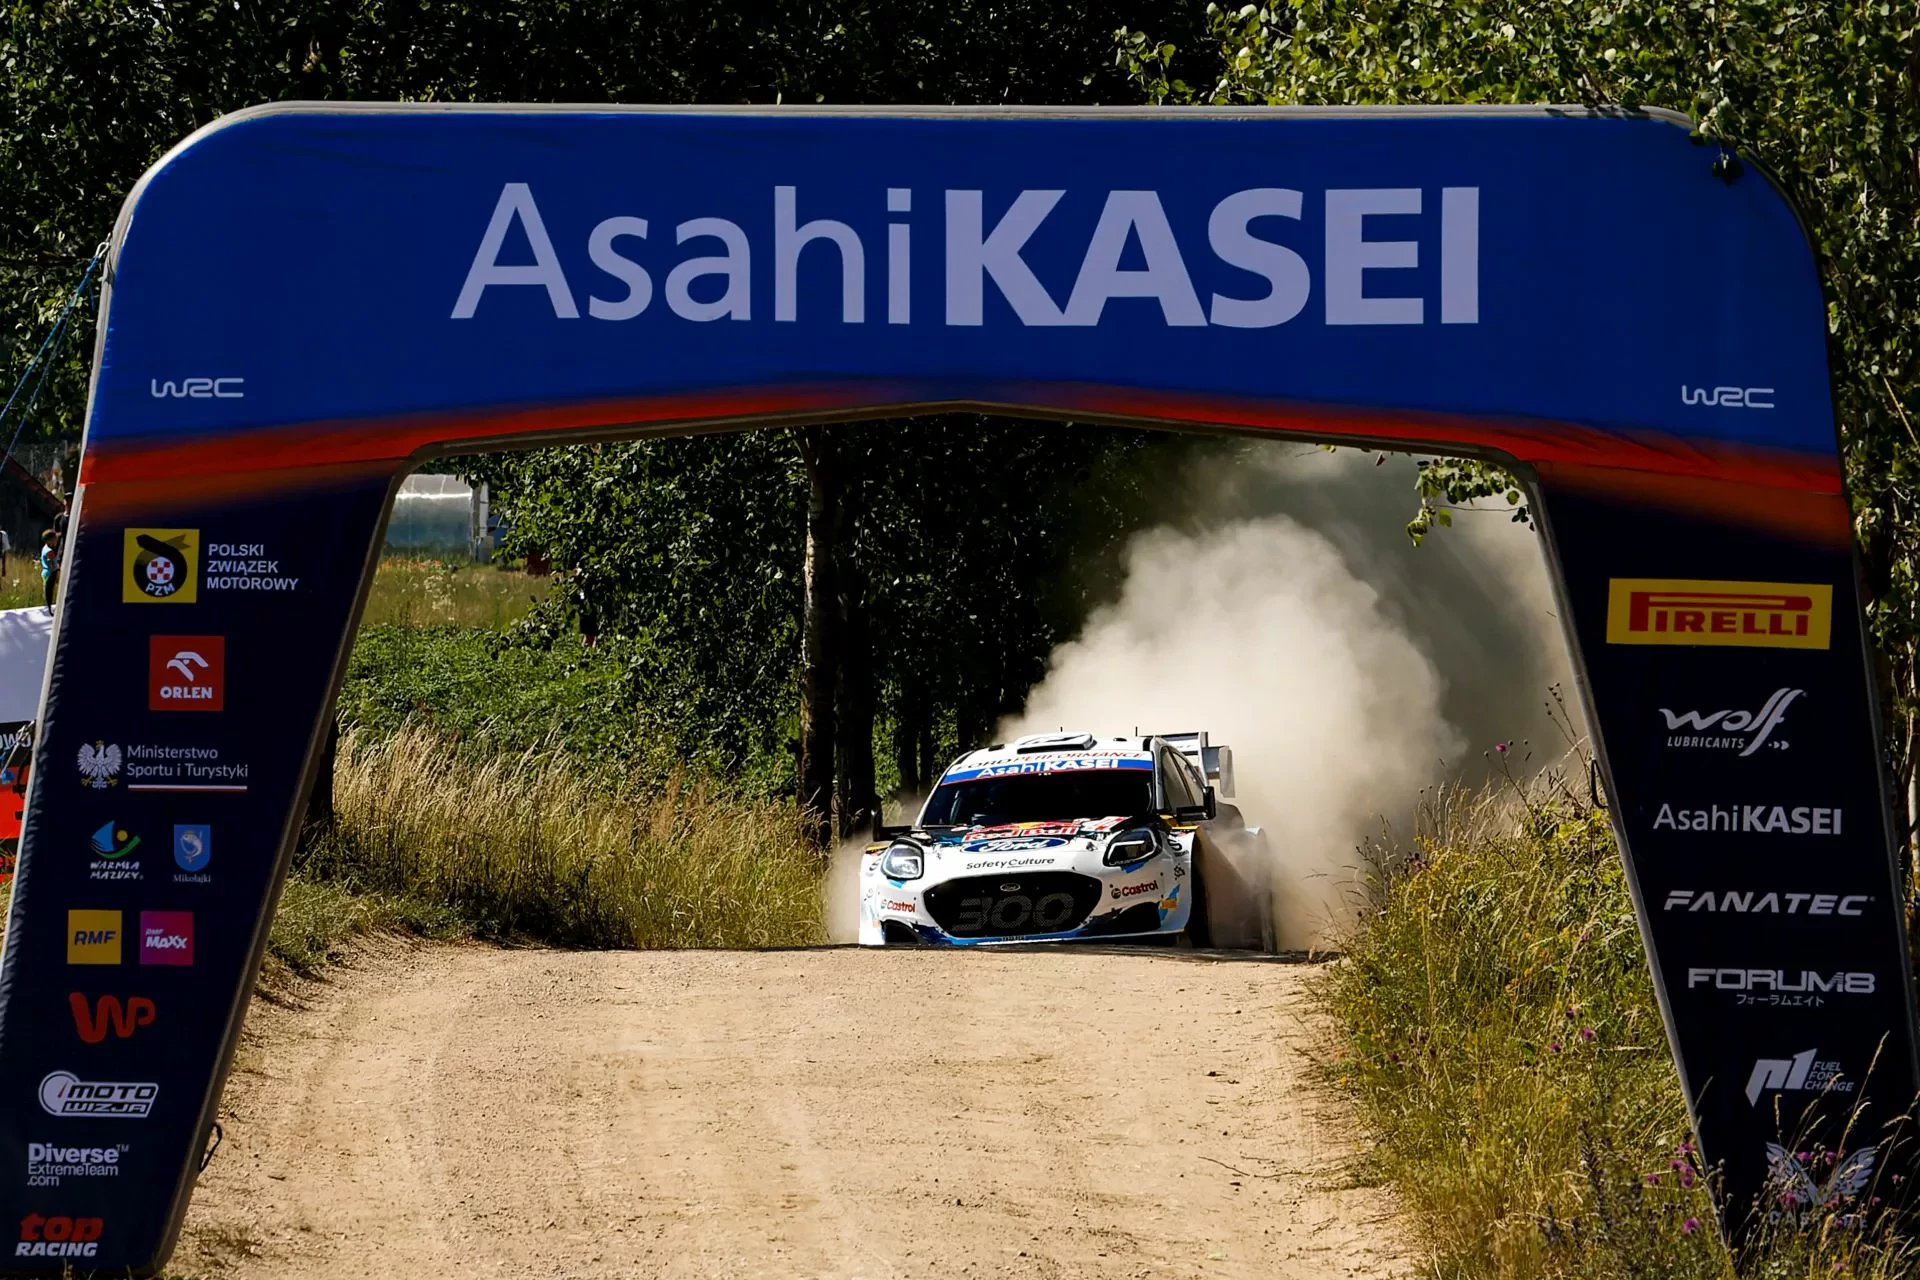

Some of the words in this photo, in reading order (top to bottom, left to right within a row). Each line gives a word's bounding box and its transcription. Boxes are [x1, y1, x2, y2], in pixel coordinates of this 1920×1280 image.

[151, 378, 244, 398] WRC
[1681, 385, 1774, 408] WRC
[208, 544, 264, 557] POLSKI
[207, 560, 279, 576] ZWIĄZEK
[145, 583, 175, 597] PZM
[207, 576, 299, 591] MOTOROWY
[1629, 591, 1813, 636] PIRELLI
[160, 686, 213, 699] ORLEN
[1667, 736, 1745, 749] LUBRICANTS
[127, 745, 218, 759] Ministerstwo
[127, 763, 172, 778] Sportu
[177, 763, 181, 777] i
[186, 763, 248, 780] Turystyki
[979, 838, 1048, 851] Ford
[90, 860, 140, 870] WARMIA
[90, 871, 139, 880] MAZURY
[1122, 880, 1158, 897] Castrol
[887, 900, 915, 912] Castrol
[1664, 890, 1870, 916] FANATEC
[74, 930, 116, 945] RMF
[145, 928, 164, 936] RMF
[1688, 968, 1875, 994] FORUM8
[1736, 994, 1825, 1007] フォーラムエイト
[69, 991, 156, 1044] WP
[1812, 1061, 1841, 1071] FUEL
[1809, 1071, 1835, 1081] FOR
[68, 1085, 156, 1099] MOTO
[1804, 1081, 1854, 1092] CHANGE
[63, 1102, 147, 1113] WIZJA
[28, 1143, 119, 1163] Diverse
[28, 1163, 118, 1176] ExtremeTeam
[27, 1175, 59, 1187] .com
[20, 1212, 104, 1242] top
[15, 1242, 98, 1257] RACING
